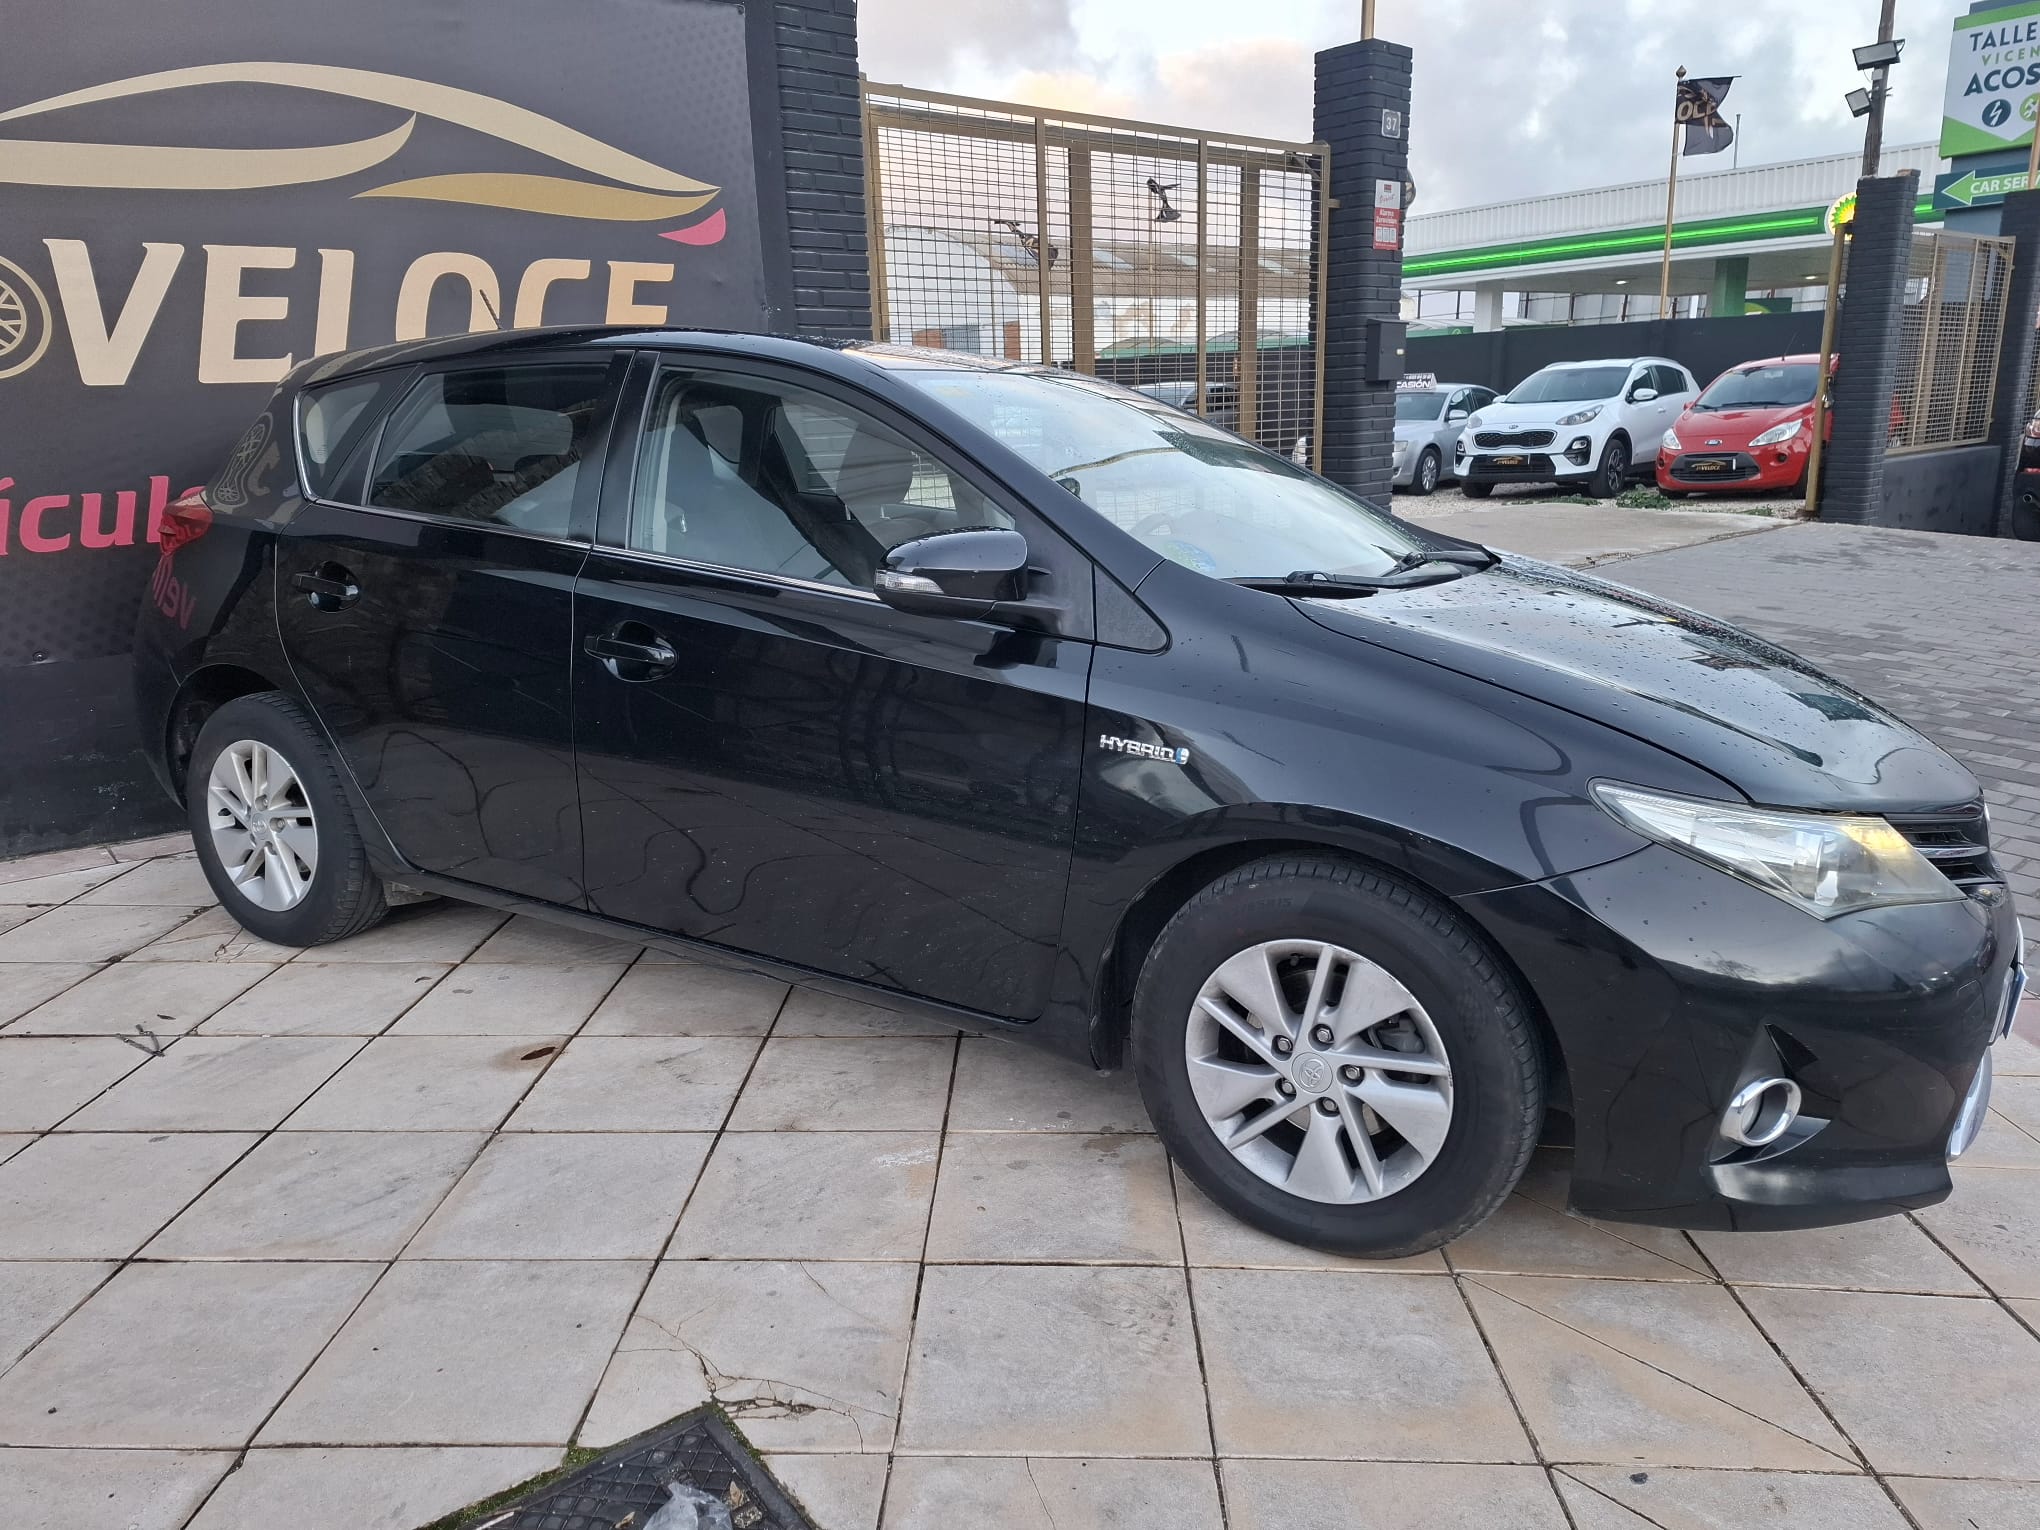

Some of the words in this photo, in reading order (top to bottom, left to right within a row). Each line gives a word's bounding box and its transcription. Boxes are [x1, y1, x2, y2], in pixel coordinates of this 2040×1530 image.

[1969, 21, 2038, 52] TALLE
[1982, 45, 2040, 66] VICEN
[1963, 62, 2040, 97] ACOS
[1386, 116, 1397, 131] 37
[1970, 180, 2000, 194] CAR
[0, 476, 207, 556] ícul
[1099, 734, 1176, 763] HYBRID
